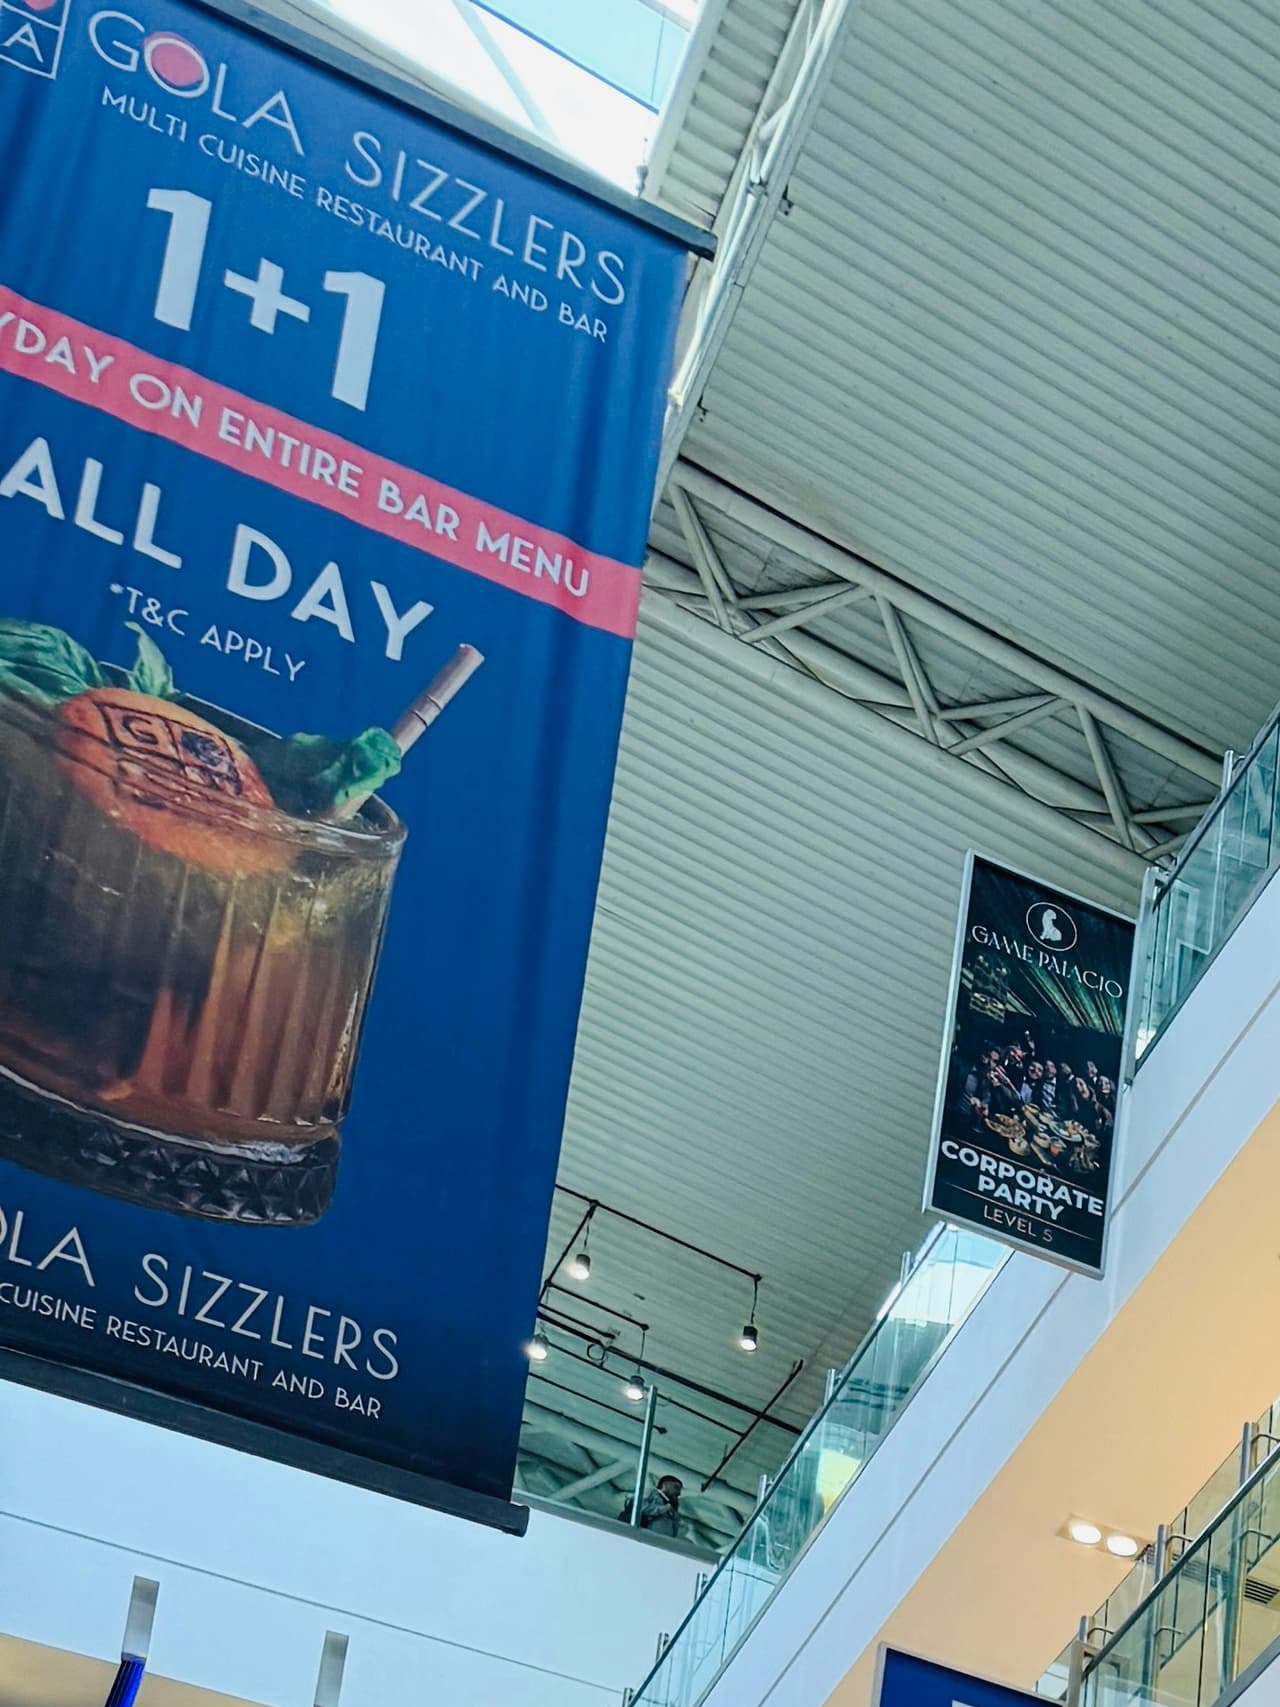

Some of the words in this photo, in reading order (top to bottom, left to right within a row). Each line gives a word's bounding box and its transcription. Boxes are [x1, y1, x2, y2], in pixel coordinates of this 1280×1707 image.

[89, 10, 304, 156] GOLA
[345, 131, 625, 305] SIZZLERS
[101, 85, 187, 142] MULTI
[199, 134, 306, 199] CUISINE
[317, 187, 484, 281] RESTAURANT
[493, 275, 547, 311] AND
[559, 302, 608, 343] BAR
[146, 188, 386, 412] 1+1
[0, 437, 183, 568] ALL
[226, 523, 434, 662] DAY
[129, 373, 202, 428] ON
[218, 407, 363, 498] ENTIRE
[377, 478, 460, 542] BAR
[475, 521, 590, 598] MENU
[201, 625, 306, 681] APPLY
[971, 925, 1034, 965] GAME
[1038, 947, 1123, 999] PALACIO
[941, 1140, 1103, 1217] CORPORATE
[978, 1174, 1065, 1221] PARTY
[983, 1204, 1037, 1237] LEVEL
[1041, 1229, 1053, 1243] 5
[0, 1204, 95, 1287] LA
[134, 1253, 399, 1380] SIZZLERS
[106, 1316, 264, 1380] RESTAURANT
[272, 1370, 324, 1399] AND
[335, 1387, 381, 1419] BAR
